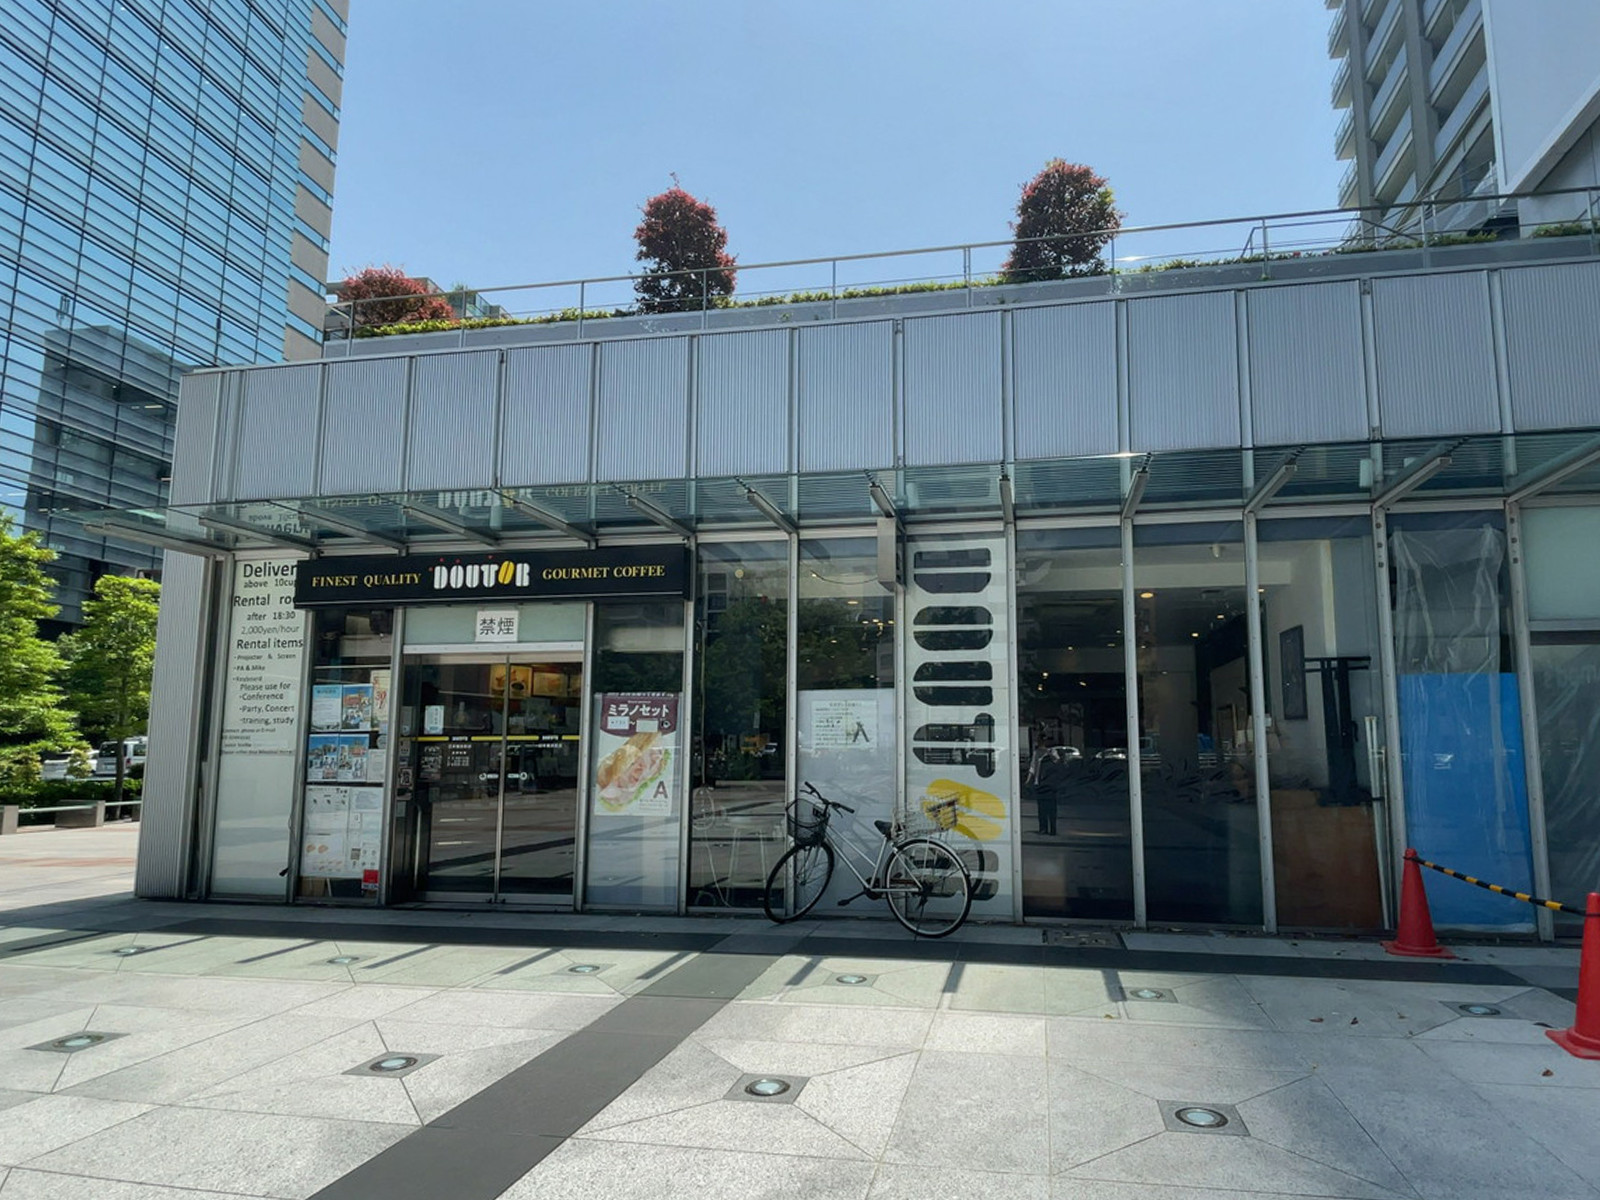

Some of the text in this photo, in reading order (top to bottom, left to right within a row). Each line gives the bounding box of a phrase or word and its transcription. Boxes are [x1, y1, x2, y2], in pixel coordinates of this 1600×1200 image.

[311, 560, 666, 589] FINEST QUALITY DOUTOR GOURMET COFFEE
[244, 580, 268, 588] above
[233, 594, 271, 607] Rental
[247, 611, 296, 621] after 18:30
[480, 617, 515, 636] 禁煙
[237, 638, 304, 649] Rental items
[279, 682, 291, 690] for
[242, 692, 284, 701] Conference
[265, 704, 295, 712] Concert
[609, 704, 670, 718] ミラノセット
[272, 717, 295, 726] study
[653, 780, 669, 799] A
